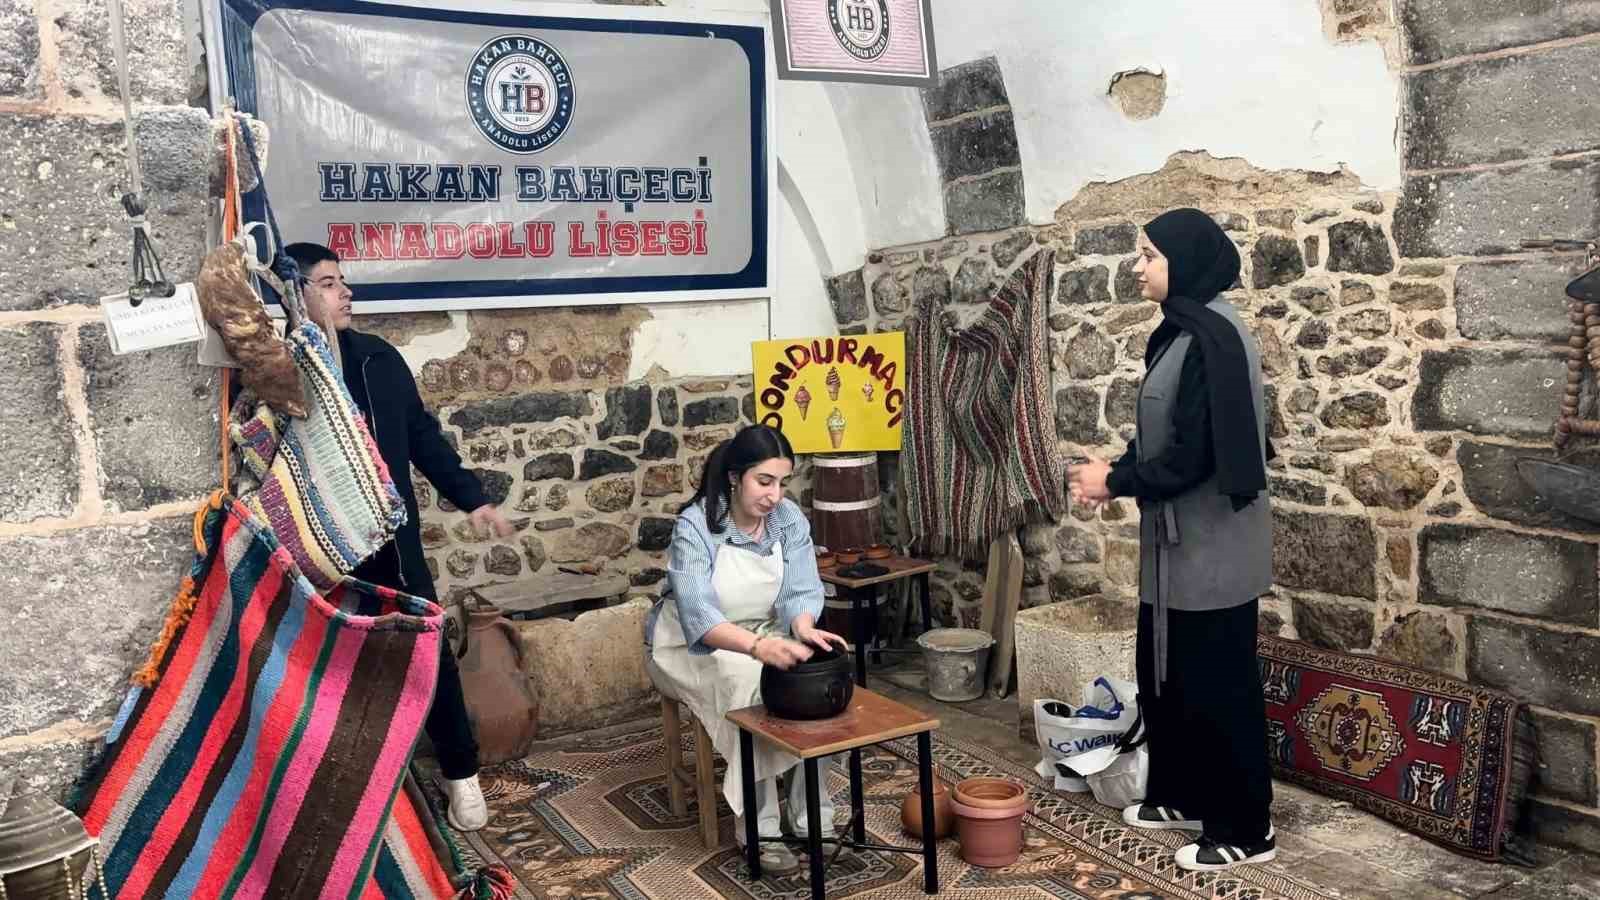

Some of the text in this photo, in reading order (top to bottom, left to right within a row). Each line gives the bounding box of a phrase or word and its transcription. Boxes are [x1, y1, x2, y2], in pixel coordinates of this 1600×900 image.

[847, 5, 874, 31] HB
[471, 40, 512, 87] HAKAN
[499, 83, 545, 114] HB
[481, 119, 528, 148] ANADOLU
[319, 156, 713, 213] HAKAN BAHÇECİ
[327, 208, 708, 260] ANADOLU LİSESİ
[1048, 738, 1072, 754] LC
